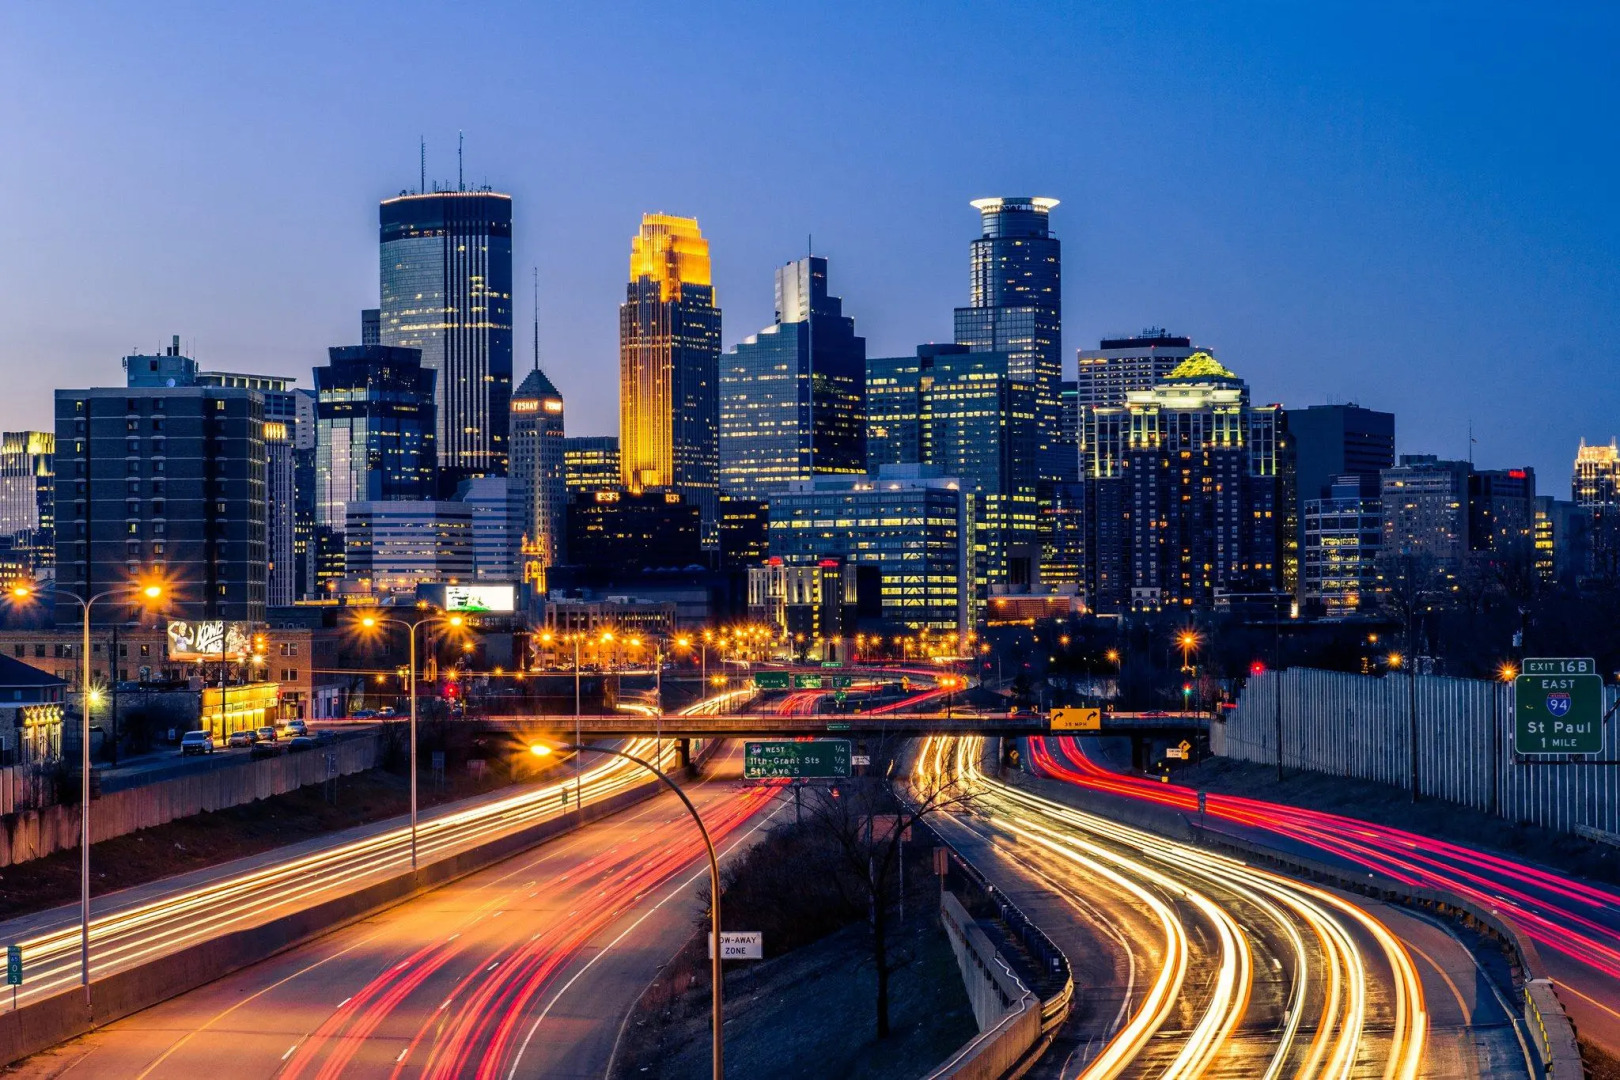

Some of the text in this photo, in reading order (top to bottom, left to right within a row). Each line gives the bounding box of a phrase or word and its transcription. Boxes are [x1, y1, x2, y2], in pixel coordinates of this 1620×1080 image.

[1530, 661, 1587, 672] EXIT 16B
[1542, 679, 1575, 689] EAST
[1550, 699, 1567, 710] 94
[1528, 721, 1591, 733] St Paul
[1541, 737, 1577, 748] 1 MILE
[750, 767, 767, 775] 5th
[771, 767, 789, 775] Ave
[720, 936, 757, 944] OW-AWAY
[725, 947, 746, 955] ZONE
